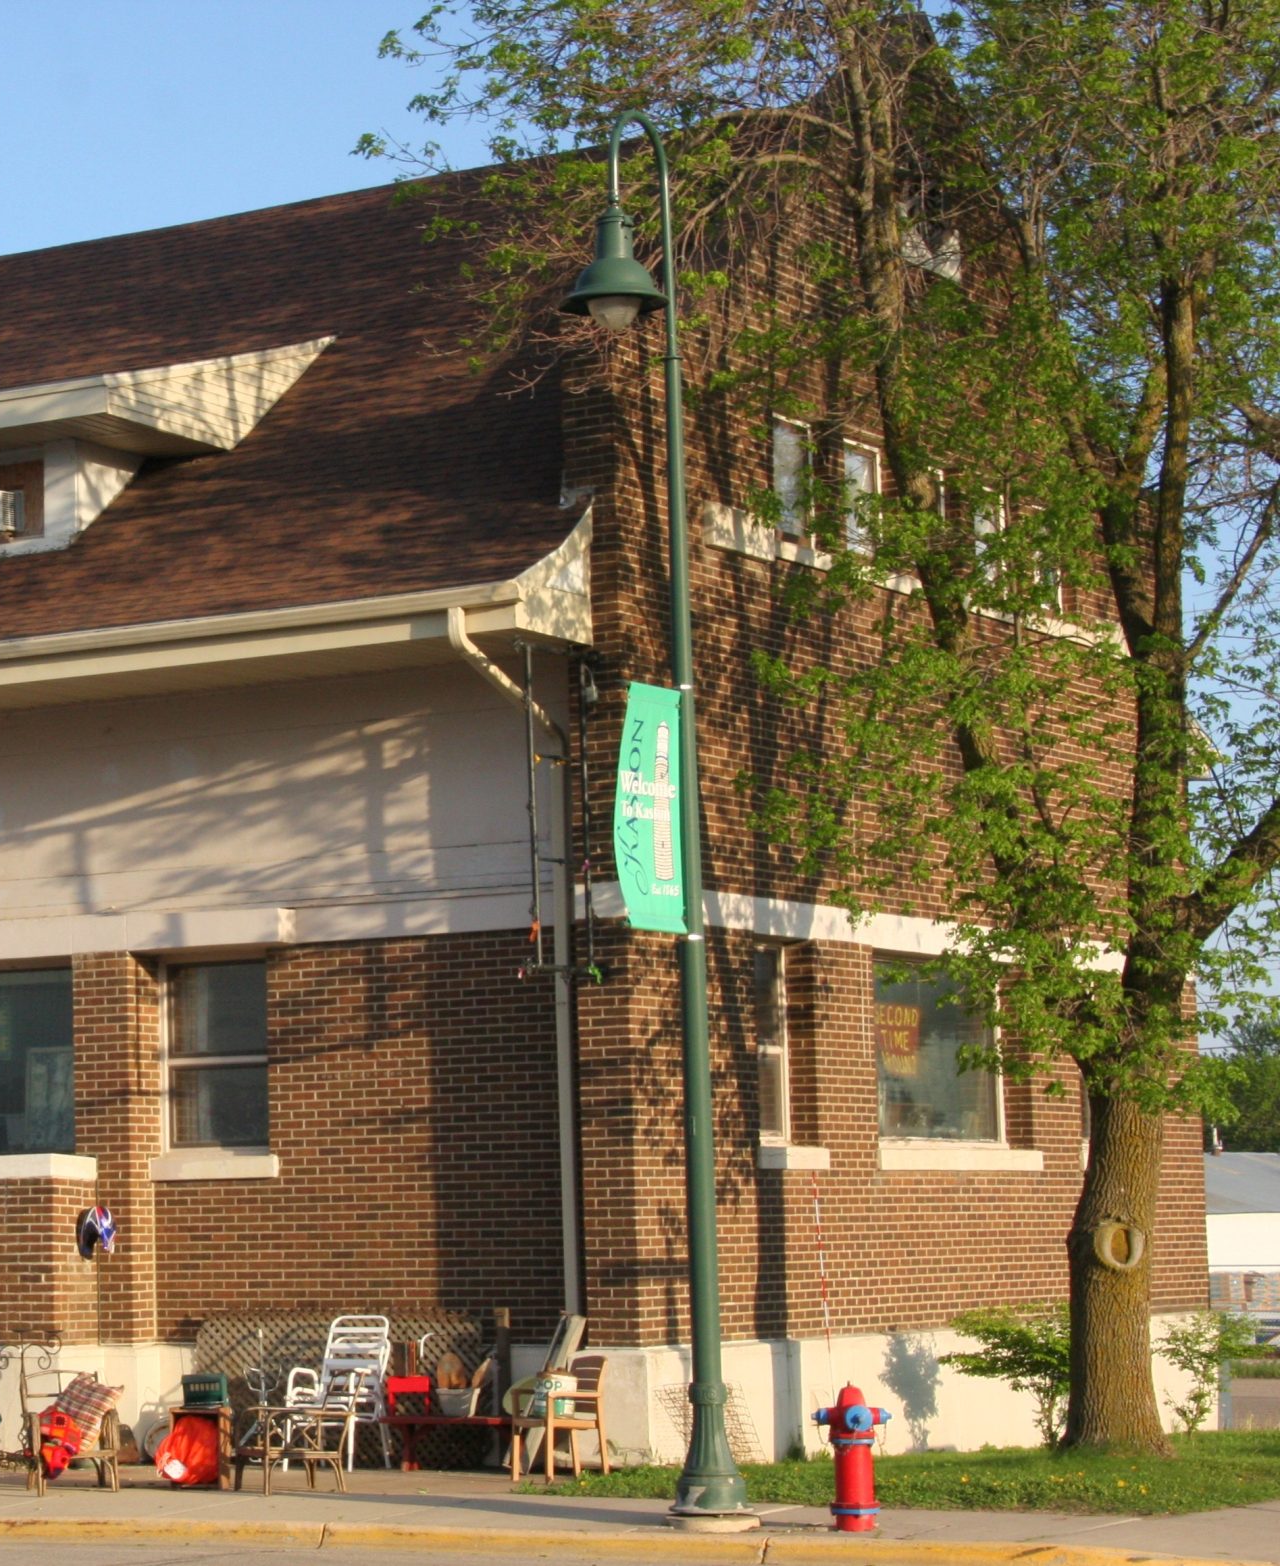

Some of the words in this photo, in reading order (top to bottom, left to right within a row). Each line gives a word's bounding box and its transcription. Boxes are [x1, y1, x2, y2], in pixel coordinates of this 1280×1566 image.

[620, 770, 677, 799] Welcome
[617, 719, 650, 896] KAON
[620, 800, 633, 817] To
[874, 1005, 919, 1027] SECOND
[880, 1029, 910, 1051] TIME
